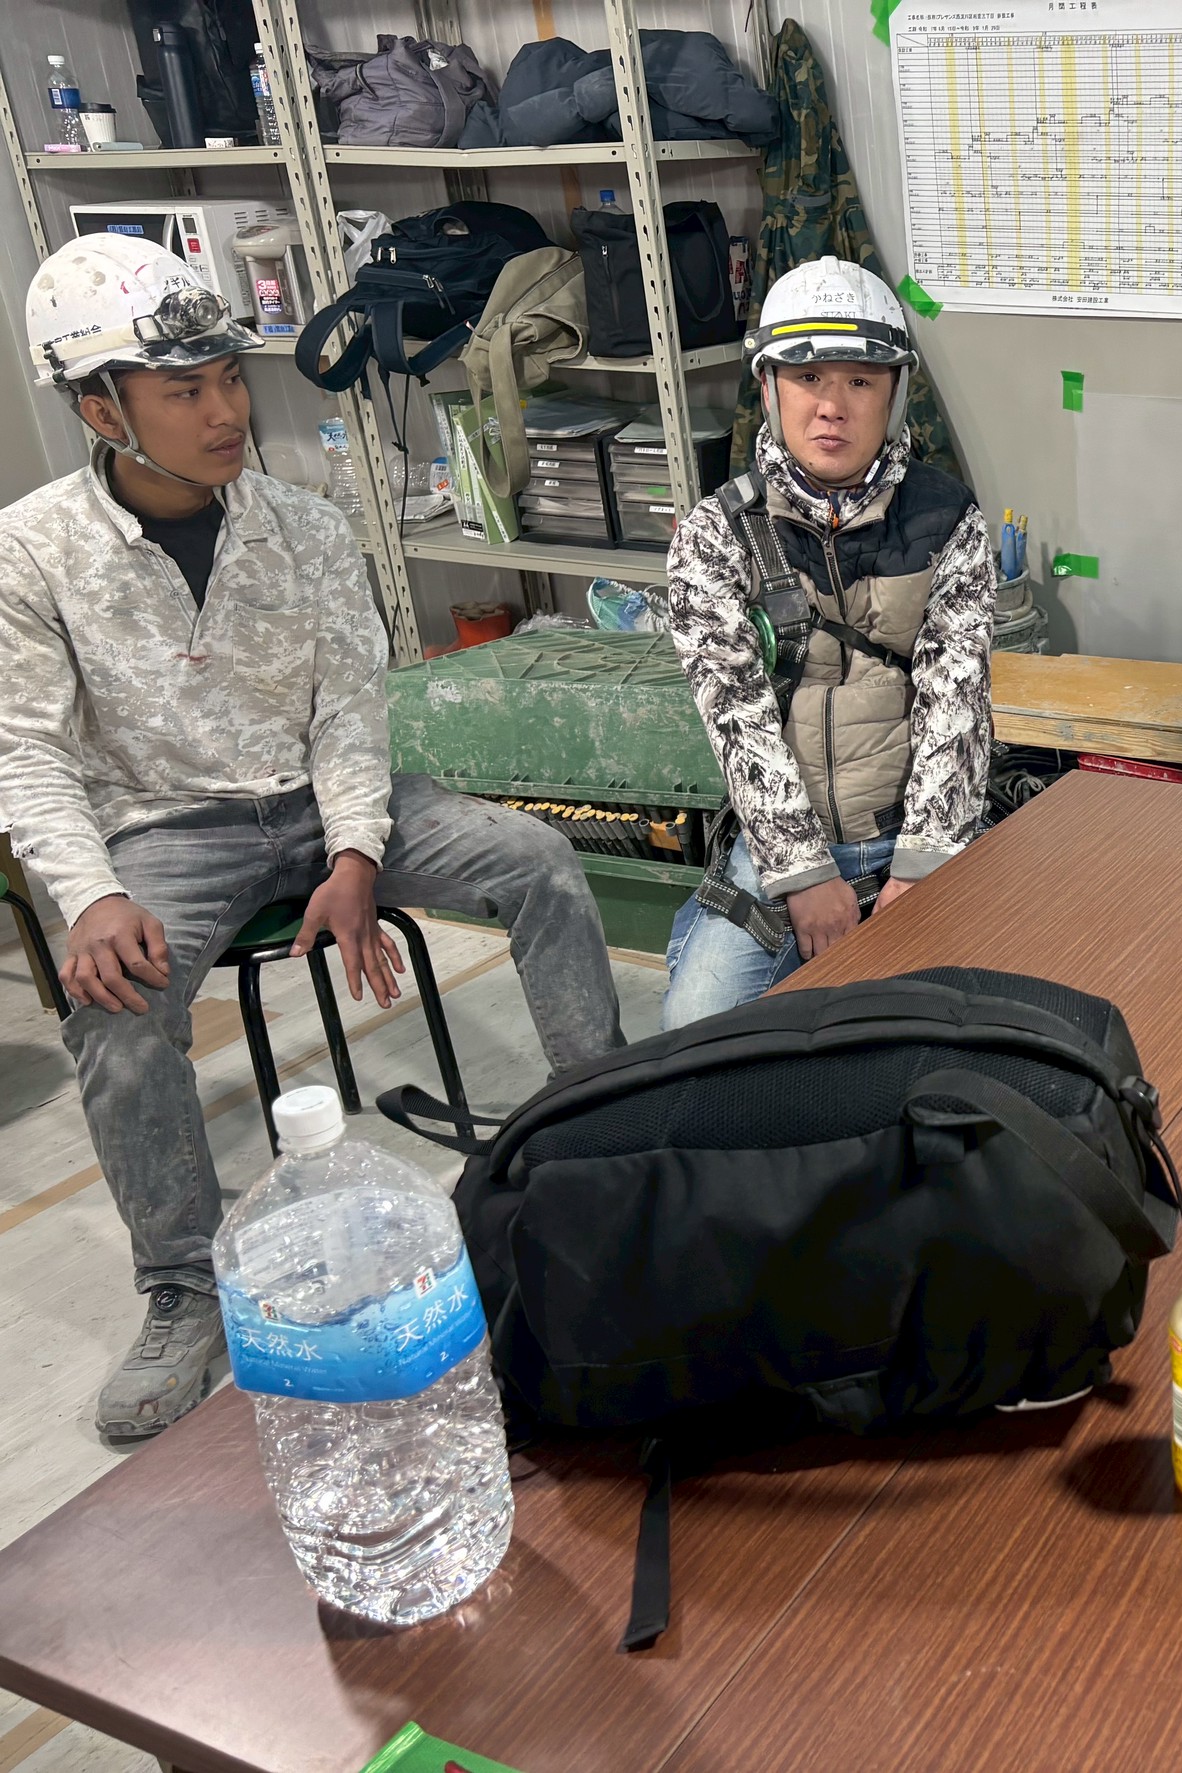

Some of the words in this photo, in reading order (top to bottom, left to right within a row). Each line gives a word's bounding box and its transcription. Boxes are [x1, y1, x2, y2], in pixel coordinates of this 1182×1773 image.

[811, 292, 856, 304] かねざき
[1052, 295, 1074, 303] 株式会社
[393, 1283, 469, 1352] 天然水
[239, 1327, 323, 1361] 天然水
